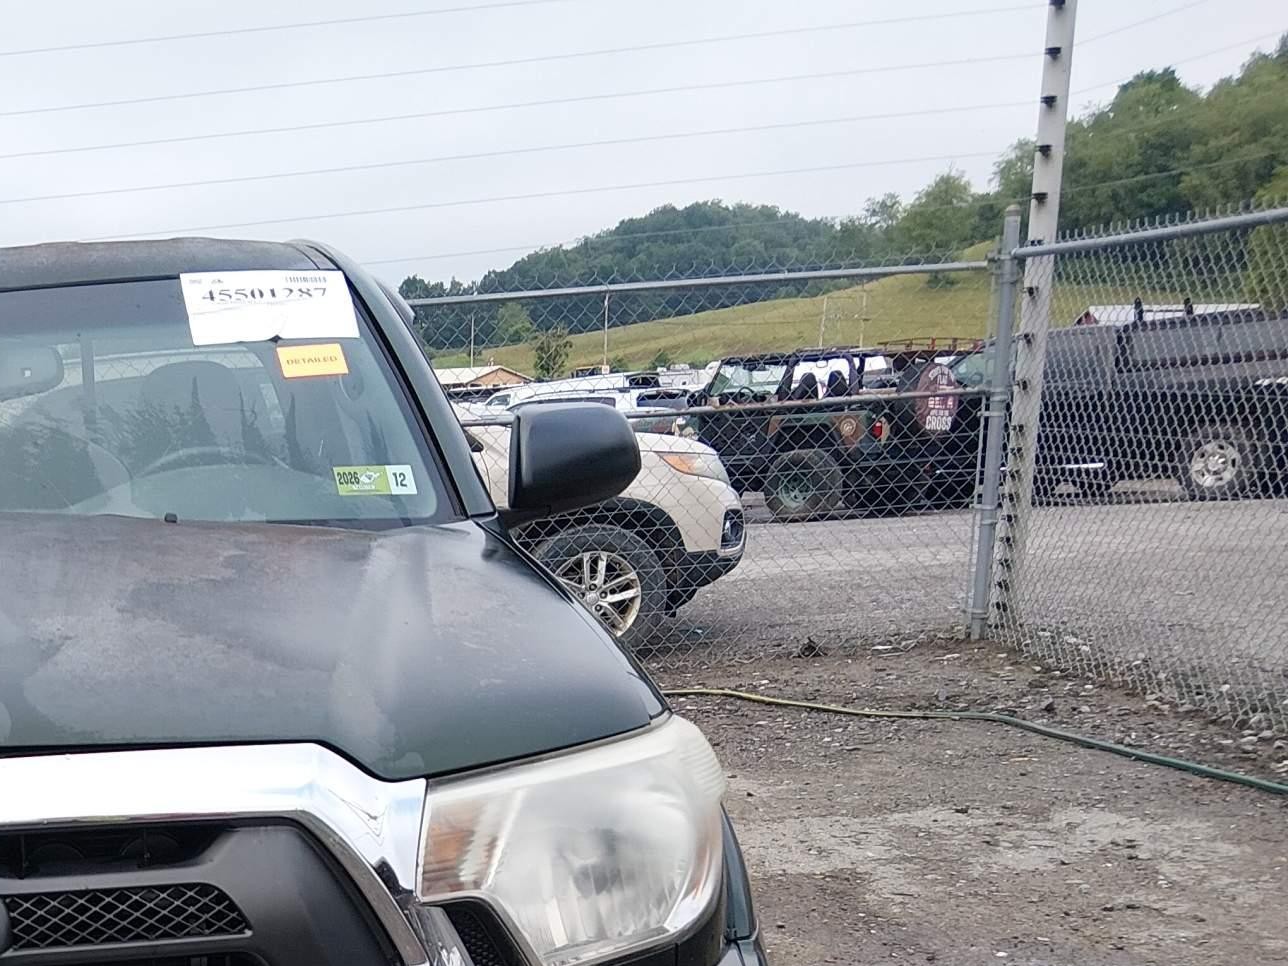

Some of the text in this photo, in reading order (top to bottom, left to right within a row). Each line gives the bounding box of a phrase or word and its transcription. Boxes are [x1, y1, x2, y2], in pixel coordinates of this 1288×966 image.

[202, 287, 327, 302] 45501287
[926, 415, 952, 430] CROSS
[337, 472, 360, 485] 2026
[392, 472, 408, 487] 12
